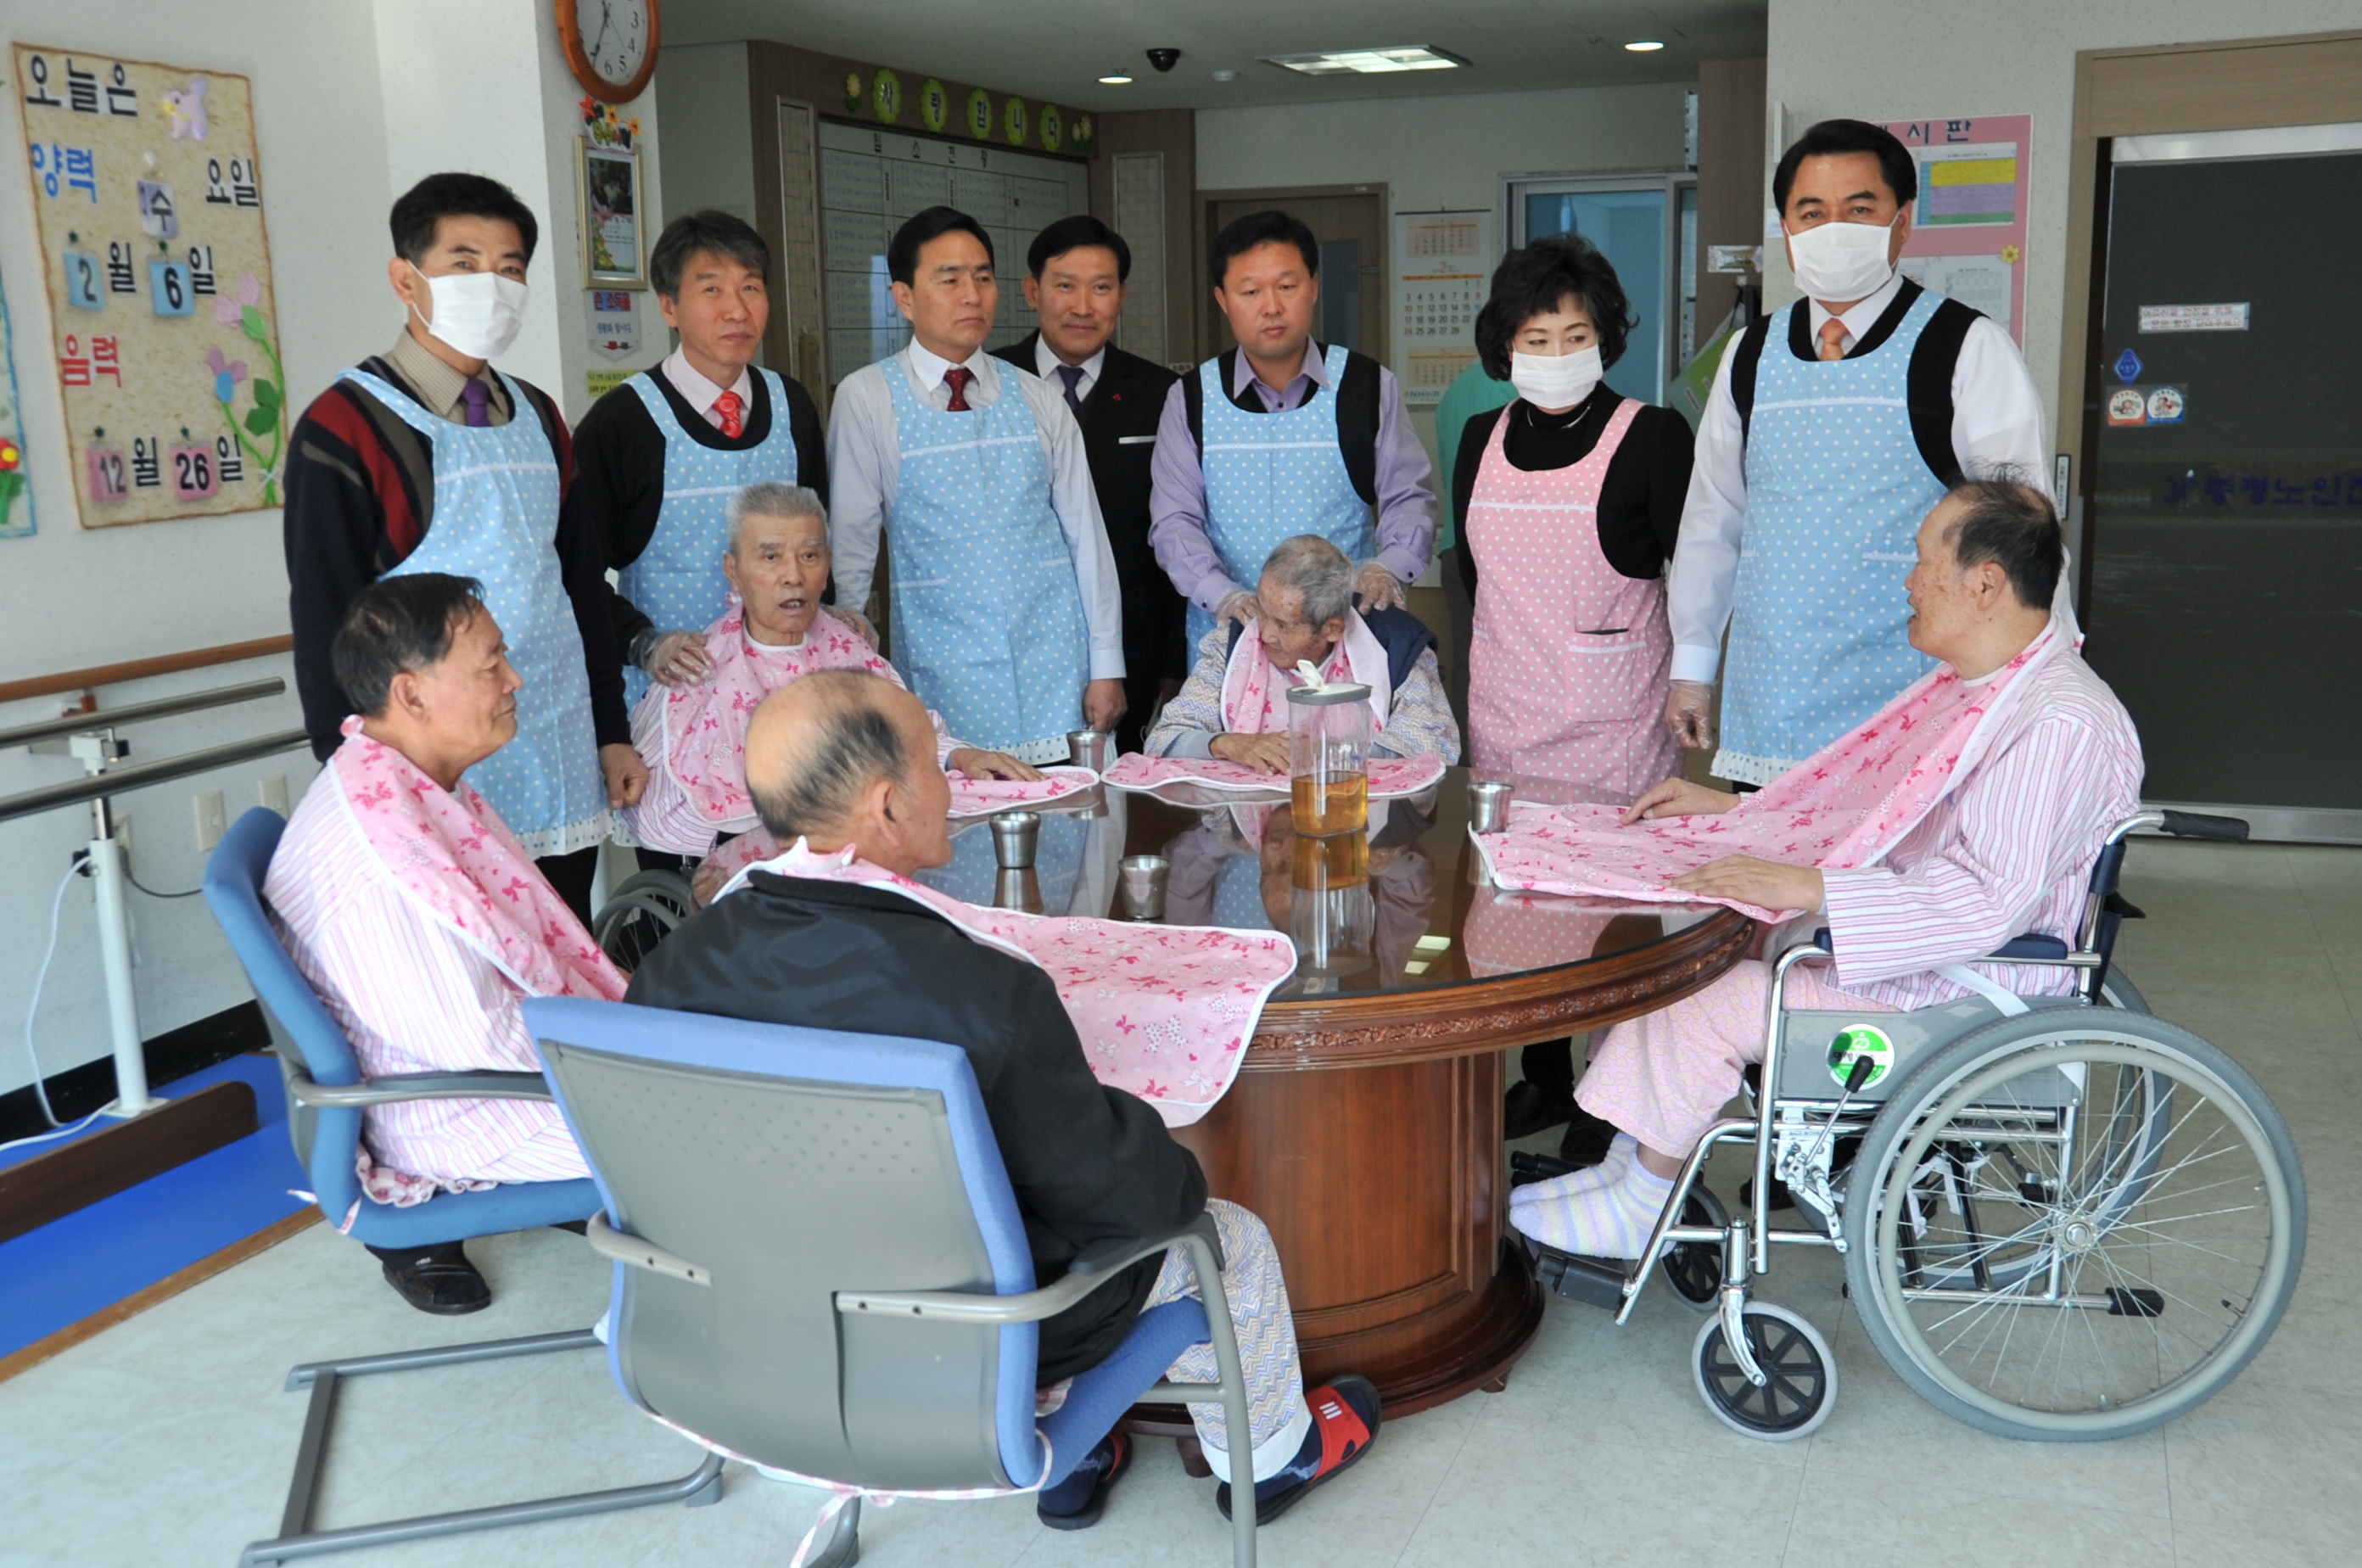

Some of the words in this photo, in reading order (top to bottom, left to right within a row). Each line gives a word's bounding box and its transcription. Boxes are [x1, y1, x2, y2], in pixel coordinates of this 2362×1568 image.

[628, 37, 635, 53] 4
[631, 10, 639, 29] 3
[26, 54, 138, 117] 오늘은
[604, 59, 613, 76] 6
[619, 54, 627, 73] 5
[1879, 120, 1972, 145] 시판
[31, 143, 98, 204] 양력
[151, 189, 173, 232] 수
[206, 159, 260, 208] 요일
[78, 258, 98, 302] 2
[107, 241, 137, 293] 월
[164, 266, 183, 310] 6
[189, 245, 217, 295] 일
[60, 334, 122, 388] 음력
[99, 455, 127, 495] 12
[132, 435, 161, 487] 월
[175, 451, 210, 490] 26
[216, 433, 243, 483] 일
